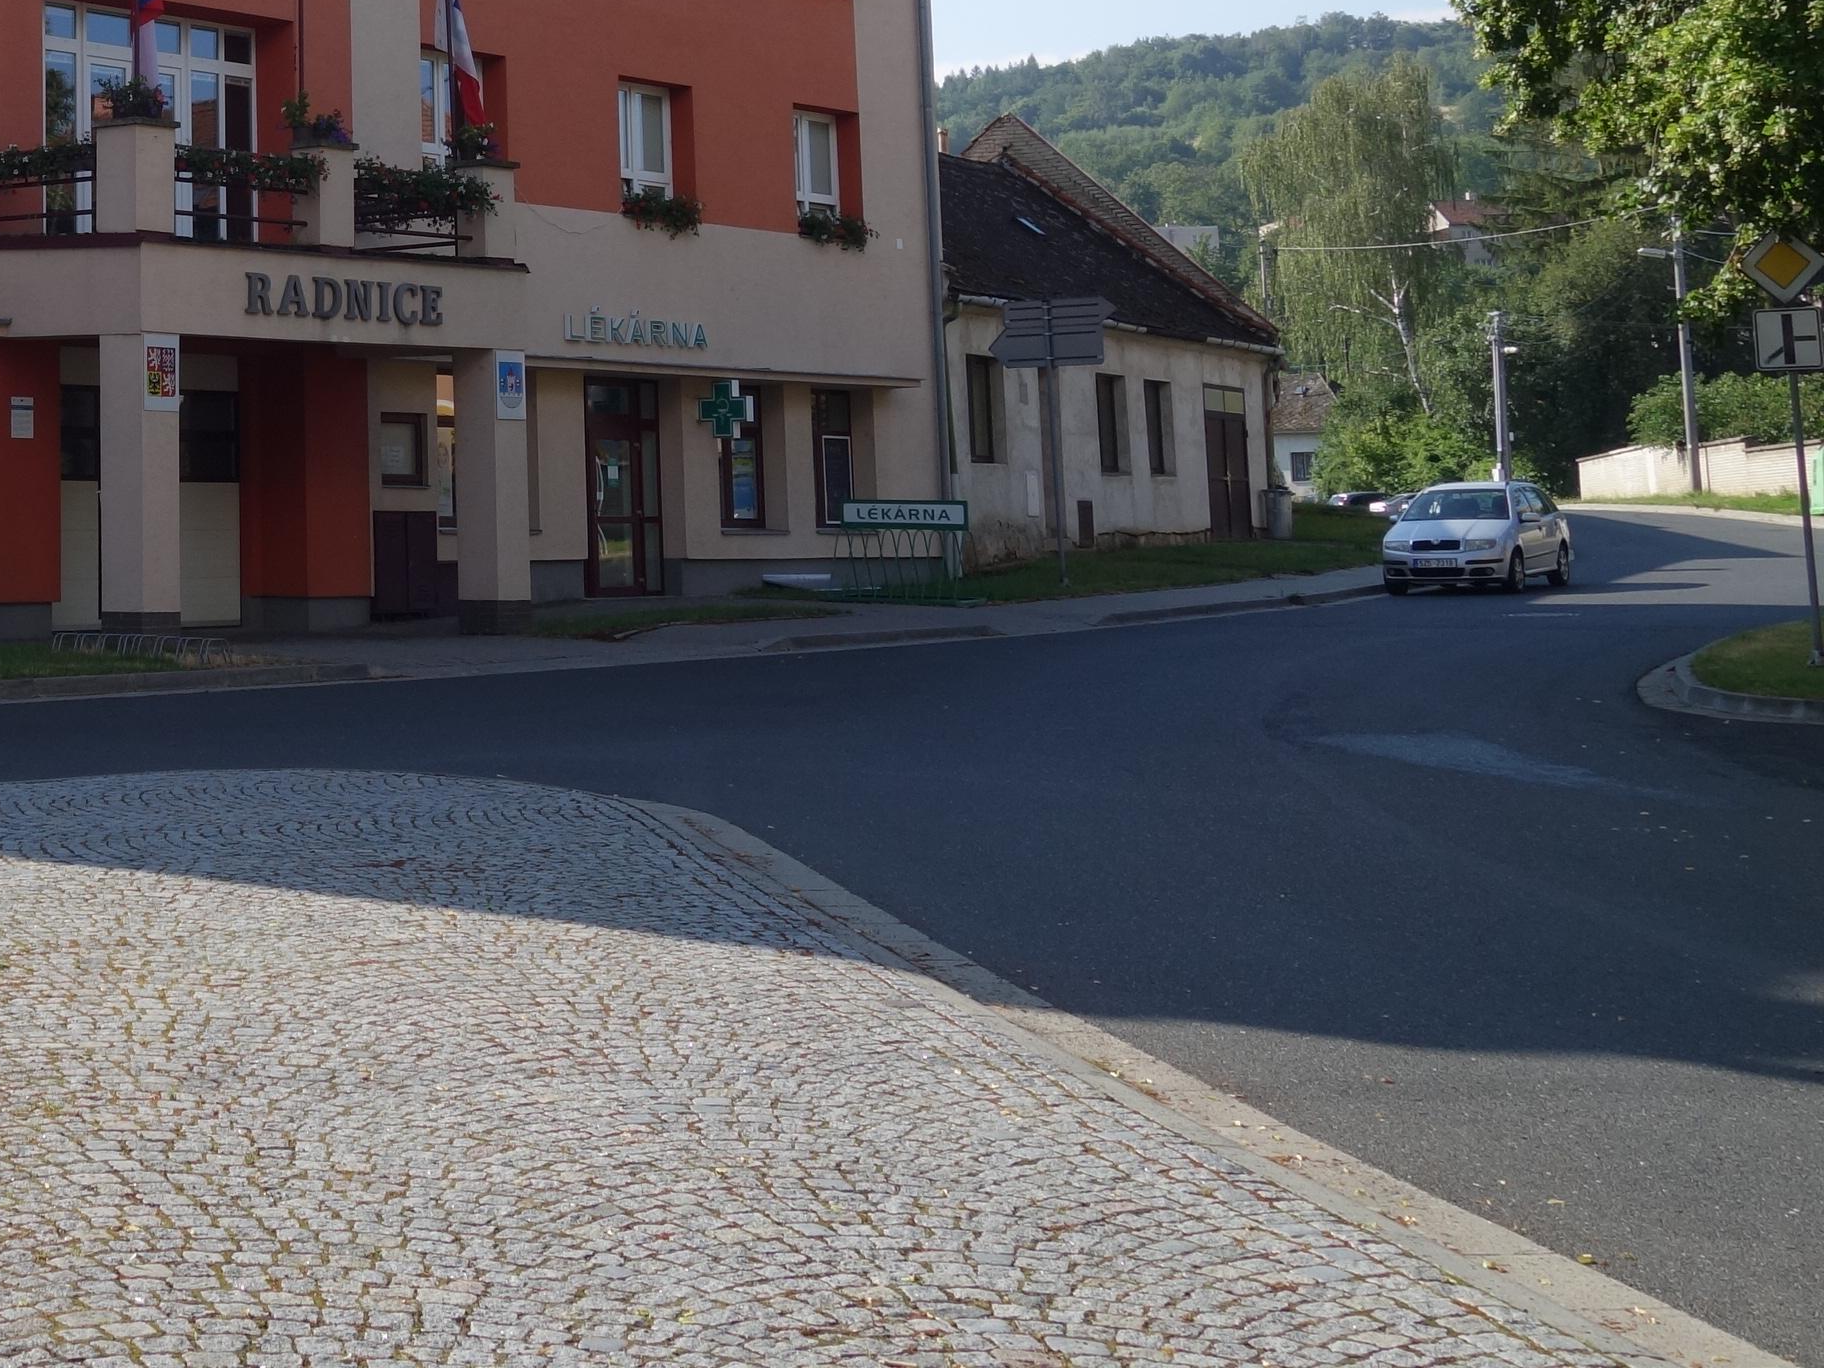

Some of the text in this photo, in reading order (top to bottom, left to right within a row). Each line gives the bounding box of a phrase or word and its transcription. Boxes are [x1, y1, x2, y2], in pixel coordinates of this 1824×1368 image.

[245, 272, 444, 325] RADNICE
[564, 305, 708, 350] LÉKÁRNA
[856, 505, 951, 521] LÉKÁRNA
